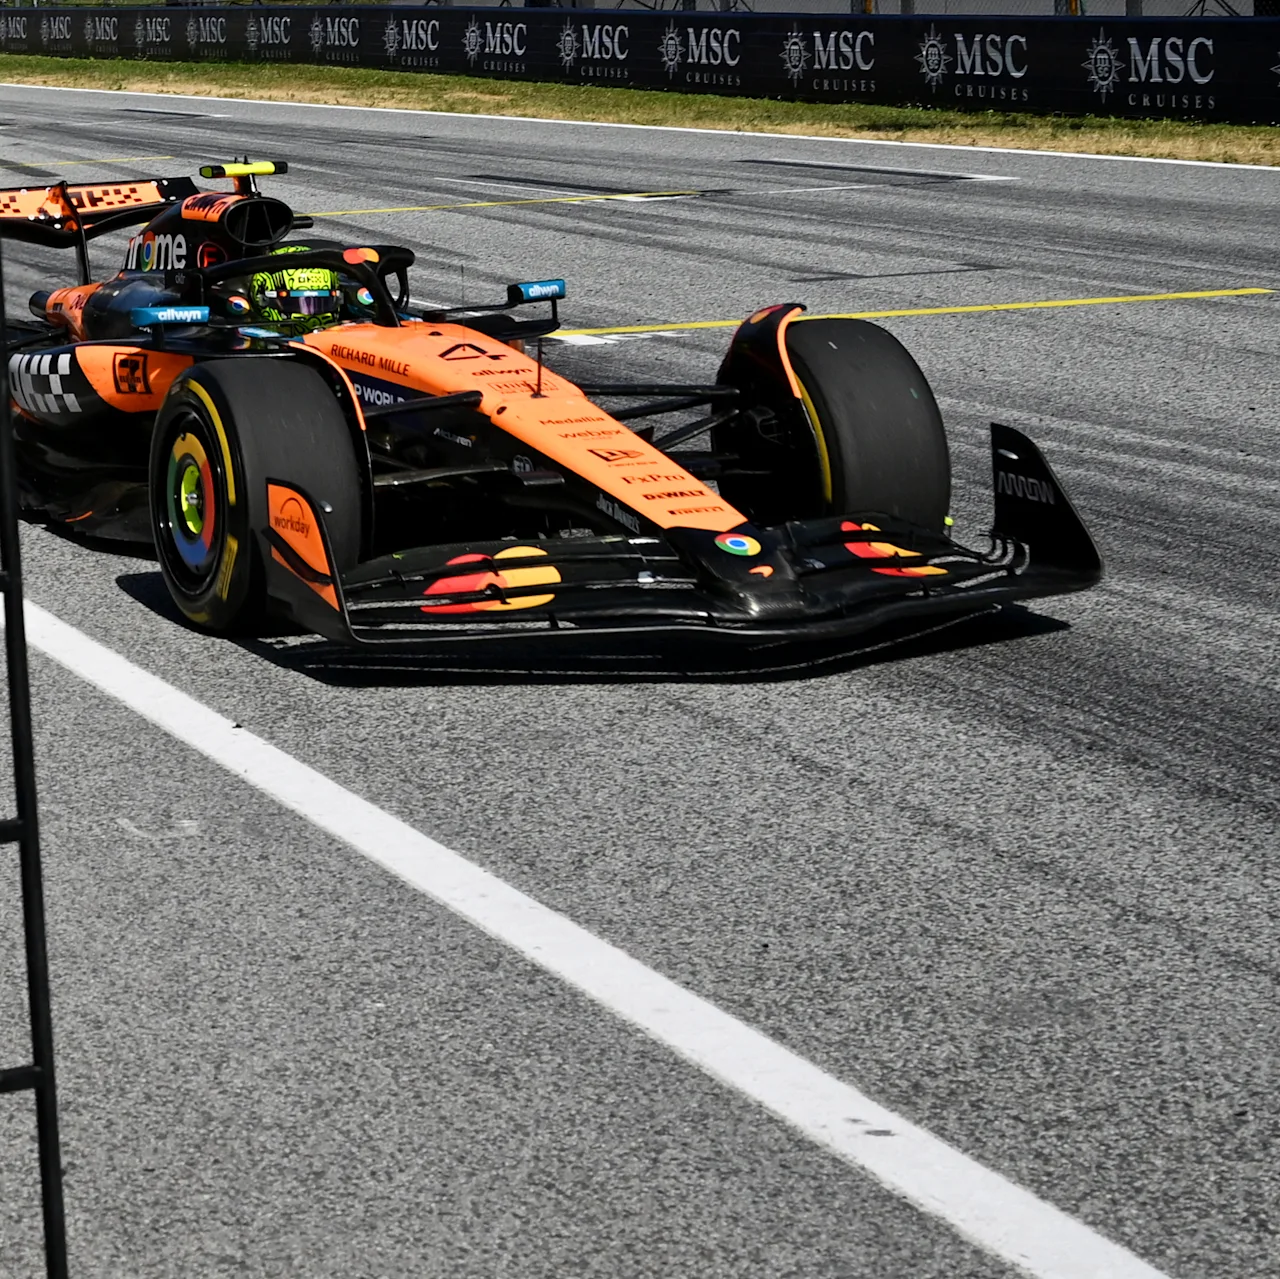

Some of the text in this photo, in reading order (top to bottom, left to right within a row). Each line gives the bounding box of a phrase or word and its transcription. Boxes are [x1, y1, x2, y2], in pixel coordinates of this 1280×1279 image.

[8, 17, 27, 39] MSC
[50, 16, 71, 40] MSC
[95, 17, 118, 41] MSC
[146, 18, 171, 42] MSC
[199, 17, 226, 43] MSC
[260, 17, 290, 44] MSC
[326, 17, 359, 47] MSC
[401, 19, 439, 50] MSC
[484, 22, 527, 56] MSC
[581, 24, 629, 60] MSC
[687, 28, 740, 66] MSC
[813, 31, 875, 70] MSC
[401, 56, 439, 67] CRUISES
[484, 61, 526, 72] CRUISES
[954, 33, 1028, 78] MSC
[1127, 37, 1214, 84] MSC
[580, 66, 629, 78] CRUISES
[686, 72, 741, 86] CRUISES
[813, 79, 876, 92] CRUISES
[955, 84, 1028, 101] CRUISES
[1128, 93, 1215, 109] CRUISES
[158, 307, 201, 322] allwyn
[331, 344, 410, 377] RICHARD MILLE
[472, 367, 533, 376] allwyn
[538, 415, 605, 425] Medallia
[558, 428, 624, 439] webex
[621, 474, 686, 484] FxPro
[274, 515, 310, 538] workday
